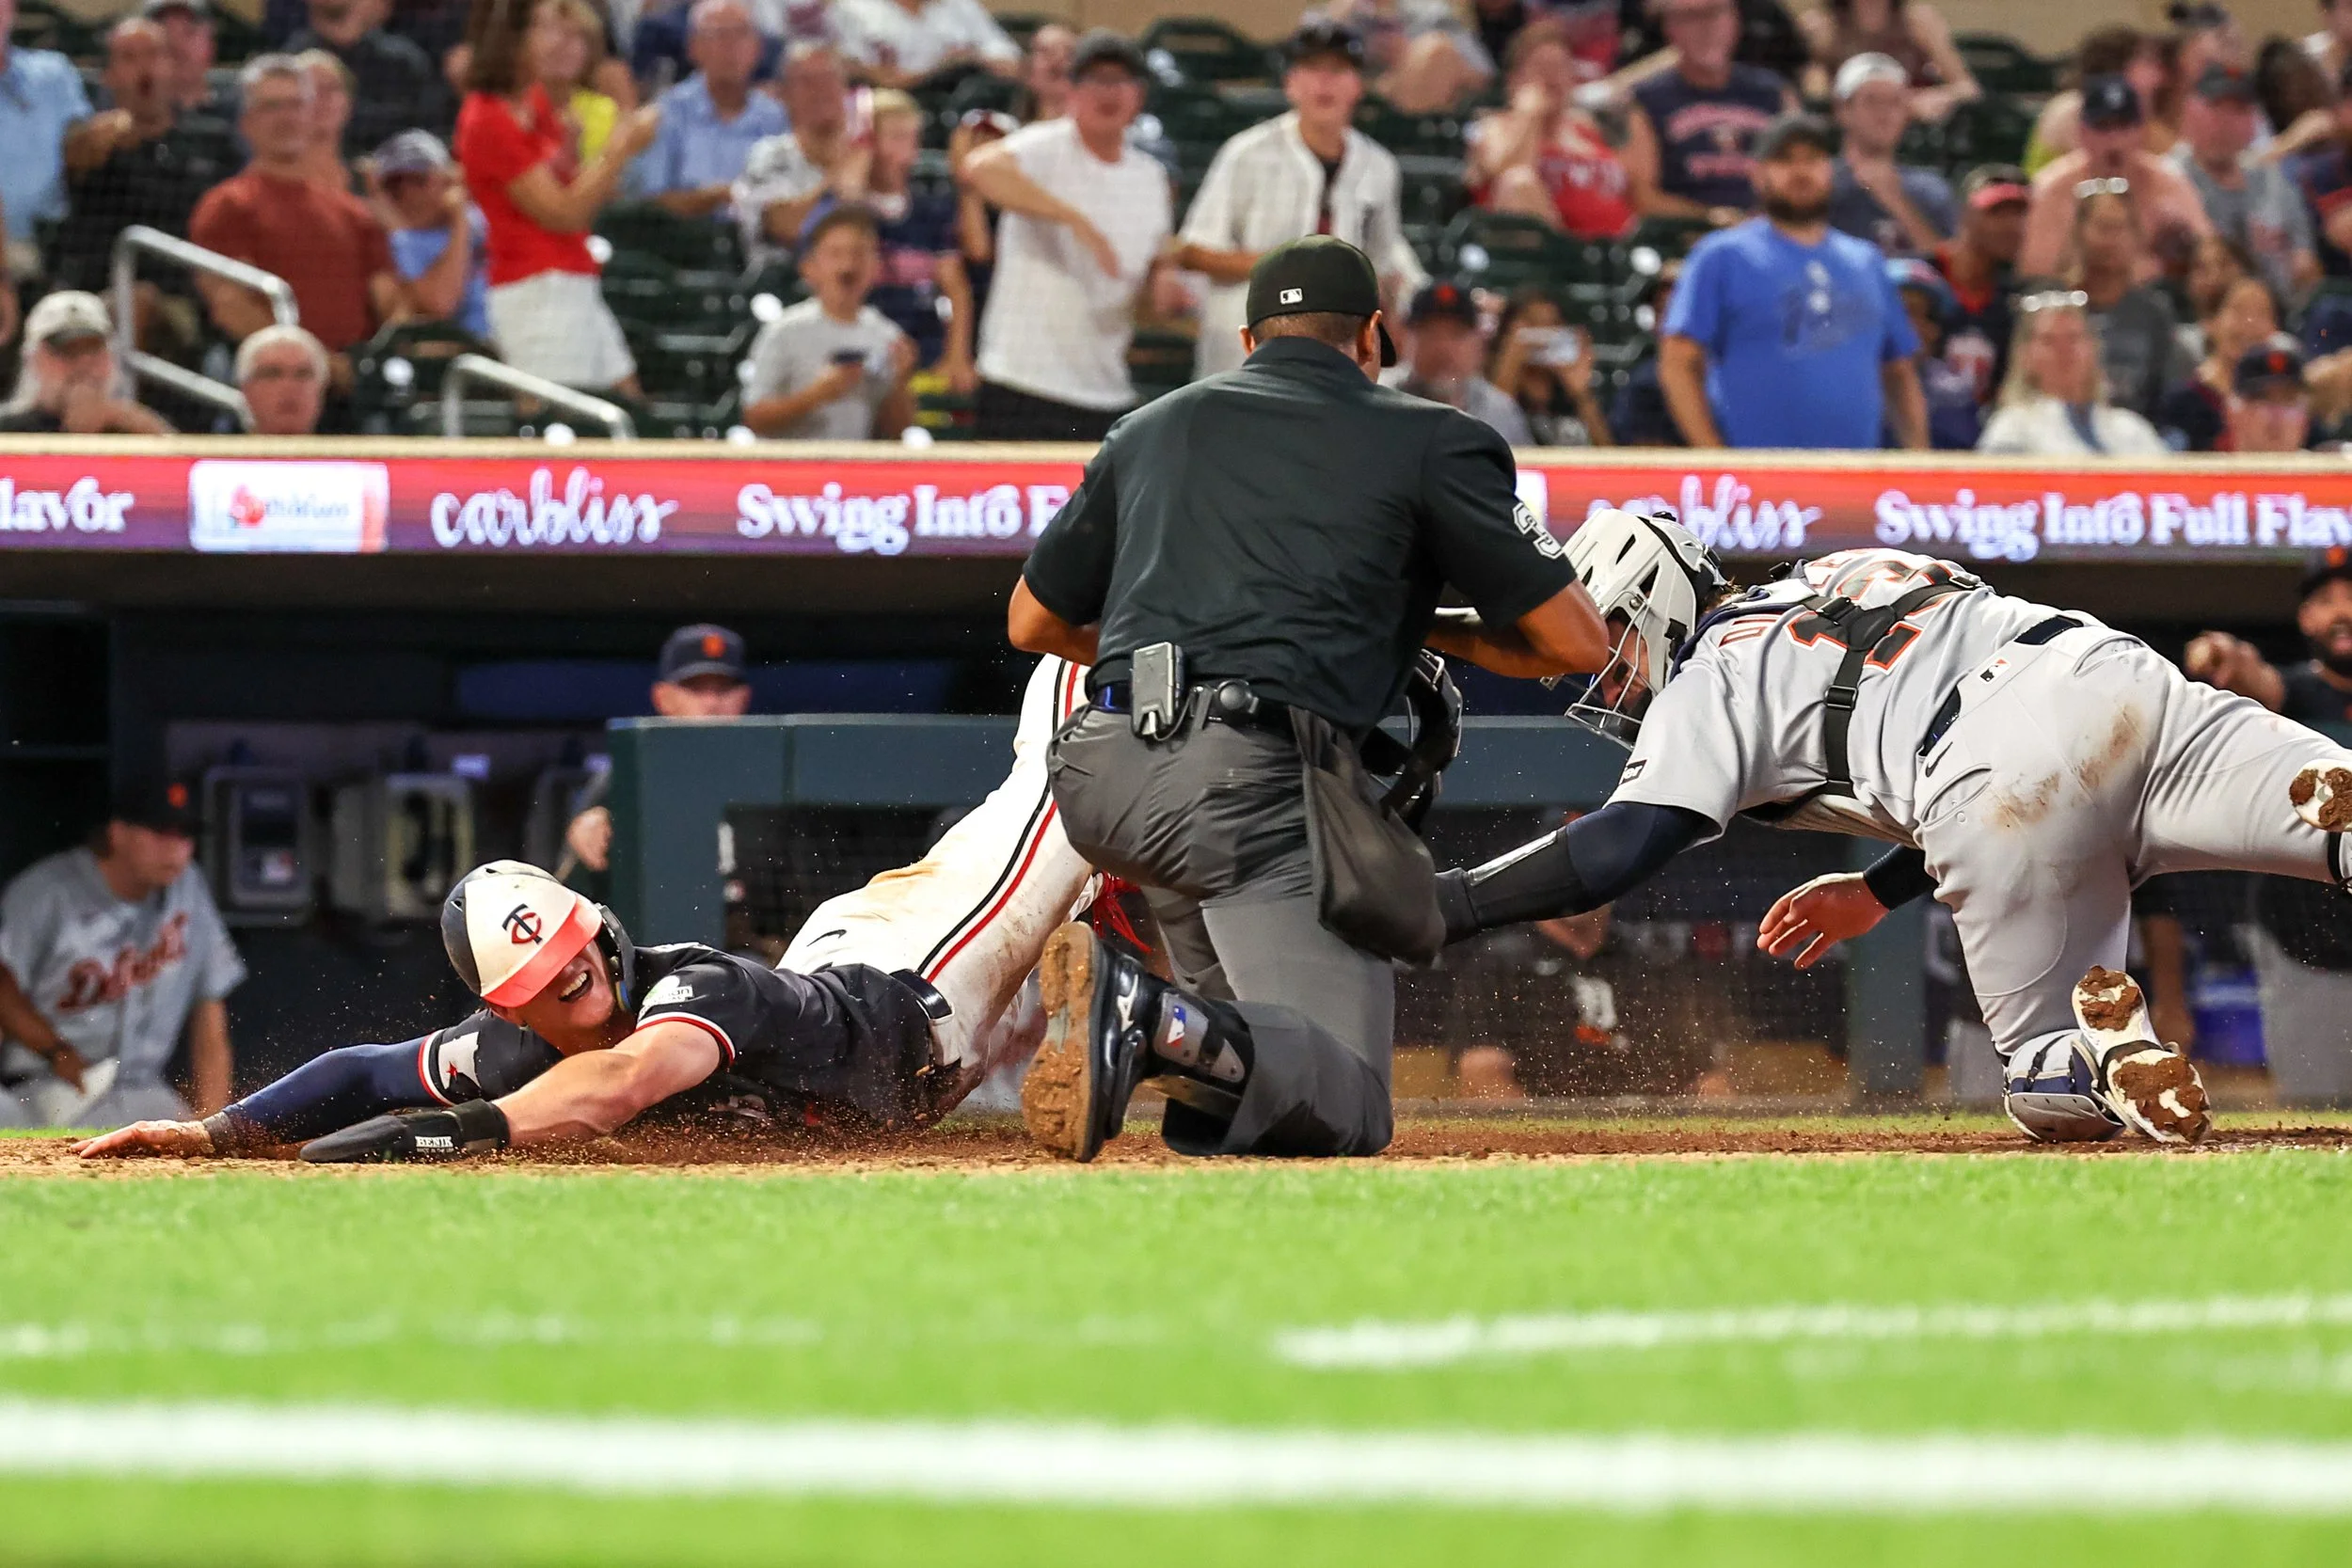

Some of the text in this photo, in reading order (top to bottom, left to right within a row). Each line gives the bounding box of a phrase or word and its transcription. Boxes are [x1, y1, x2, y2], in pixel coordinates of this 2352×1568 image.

[430, 467, 679, 547] carbliss
[737, 482, 911, 555] Swing
[913, 483, 1023, 539] Into
[1874, 488, 2040, 562] Swing
[2042, 491, 2145, 545] Into
[2149, 491, 2249, 546] Full
